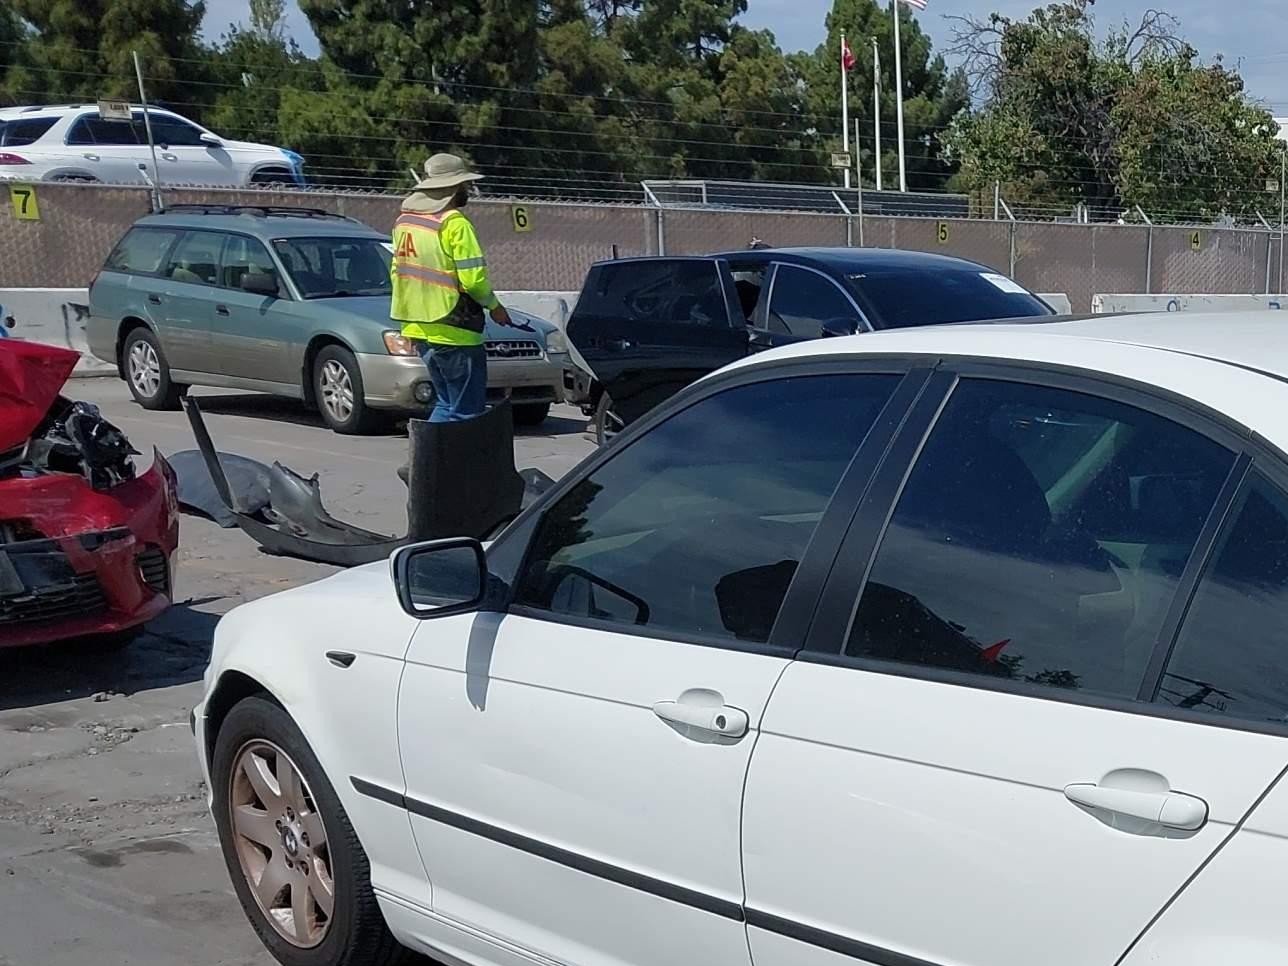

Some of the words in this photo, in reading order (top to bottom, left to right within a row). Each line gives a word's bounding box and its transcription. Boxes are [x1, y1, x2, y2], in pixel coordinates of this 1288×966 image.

[14, 190, 30, 213] 7
[515, 207, 527, 227] 6
[940, 224, 947, 240] 5
[1192, 231, 1200, 247] 4
